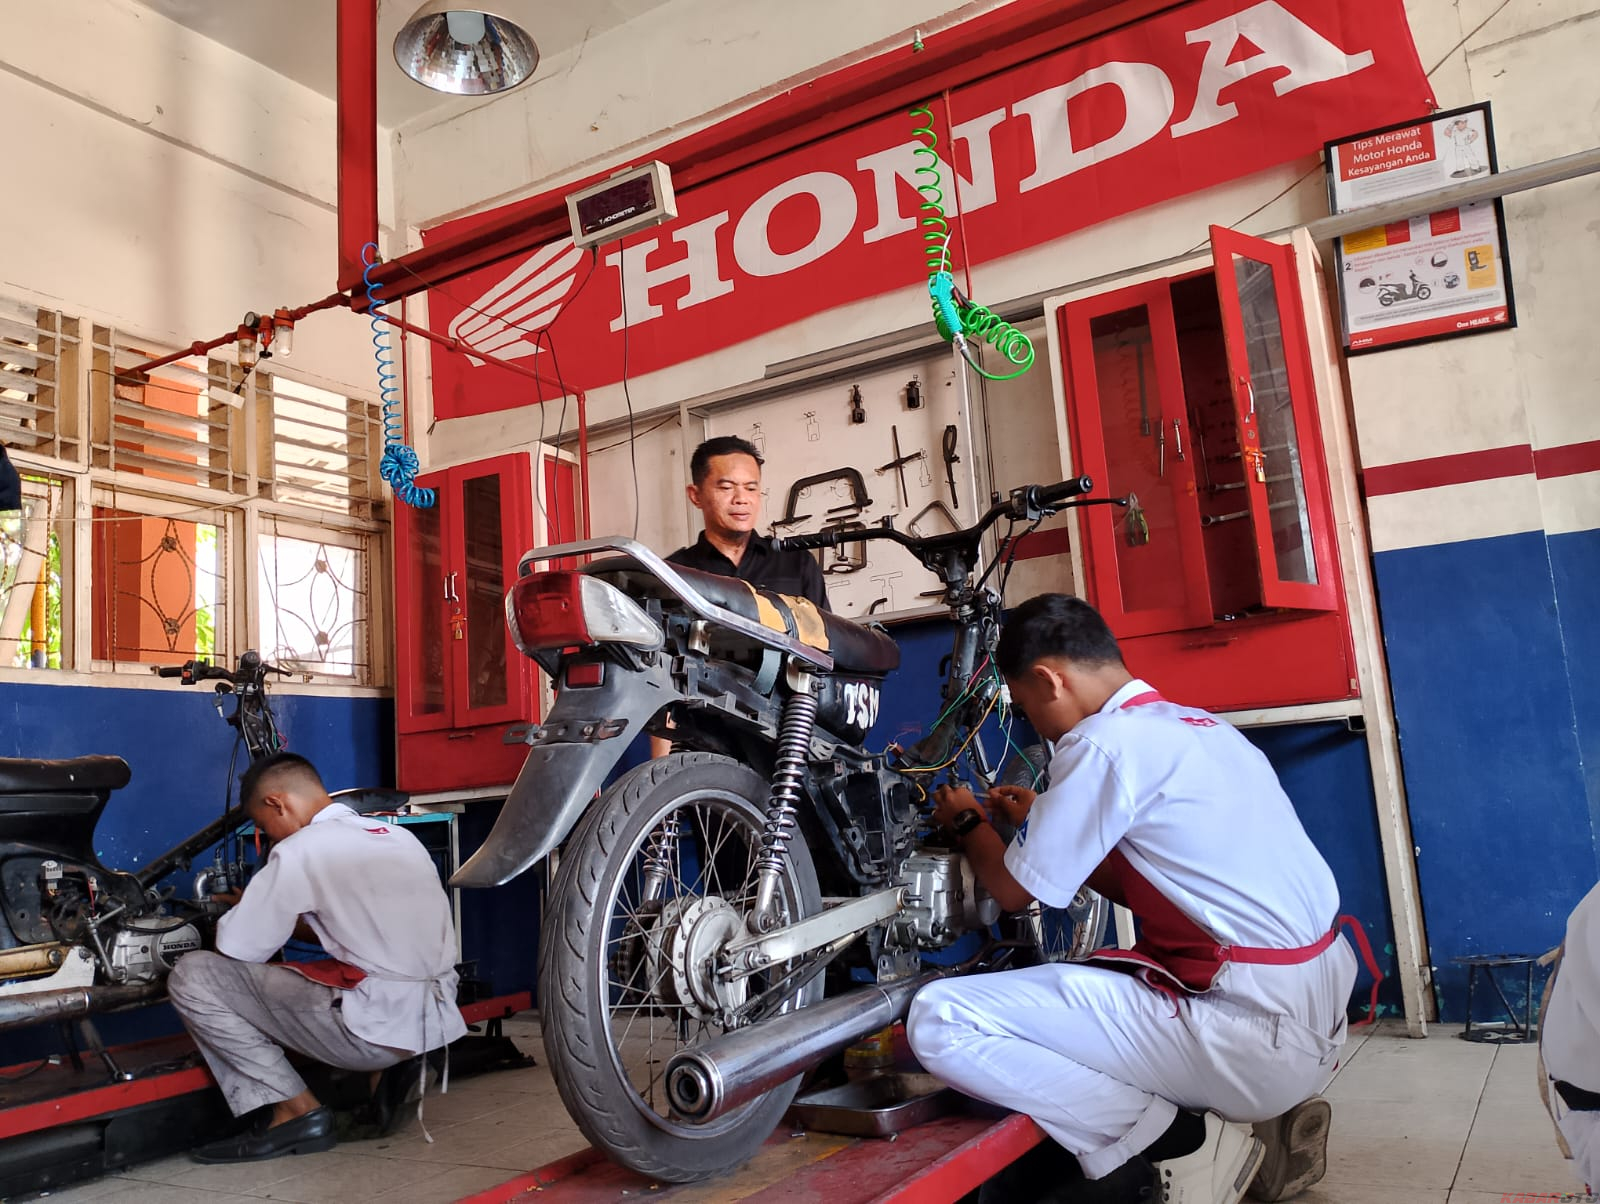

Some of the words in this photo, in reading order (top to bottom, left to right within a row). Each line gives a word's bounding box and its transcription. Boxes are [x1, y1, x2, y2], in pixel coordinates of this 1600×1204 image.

[1351, 140, 1373, 151] Tips
[1375, 127, 1421, 145] Merawat
[1347, 158, 1404, 177] Kesayangan
[1405, 151, 1431, 164] Anda
[1353, 149, 1385, 164] Motor
[1386, 140, 1423, 156] Honda
[609, 0, 1375, 333] HONDA
[1345, 262, 1352, 271] 2
[1456, 321, 1469, 329] One
[162, 941, 197, 951] HONDA
